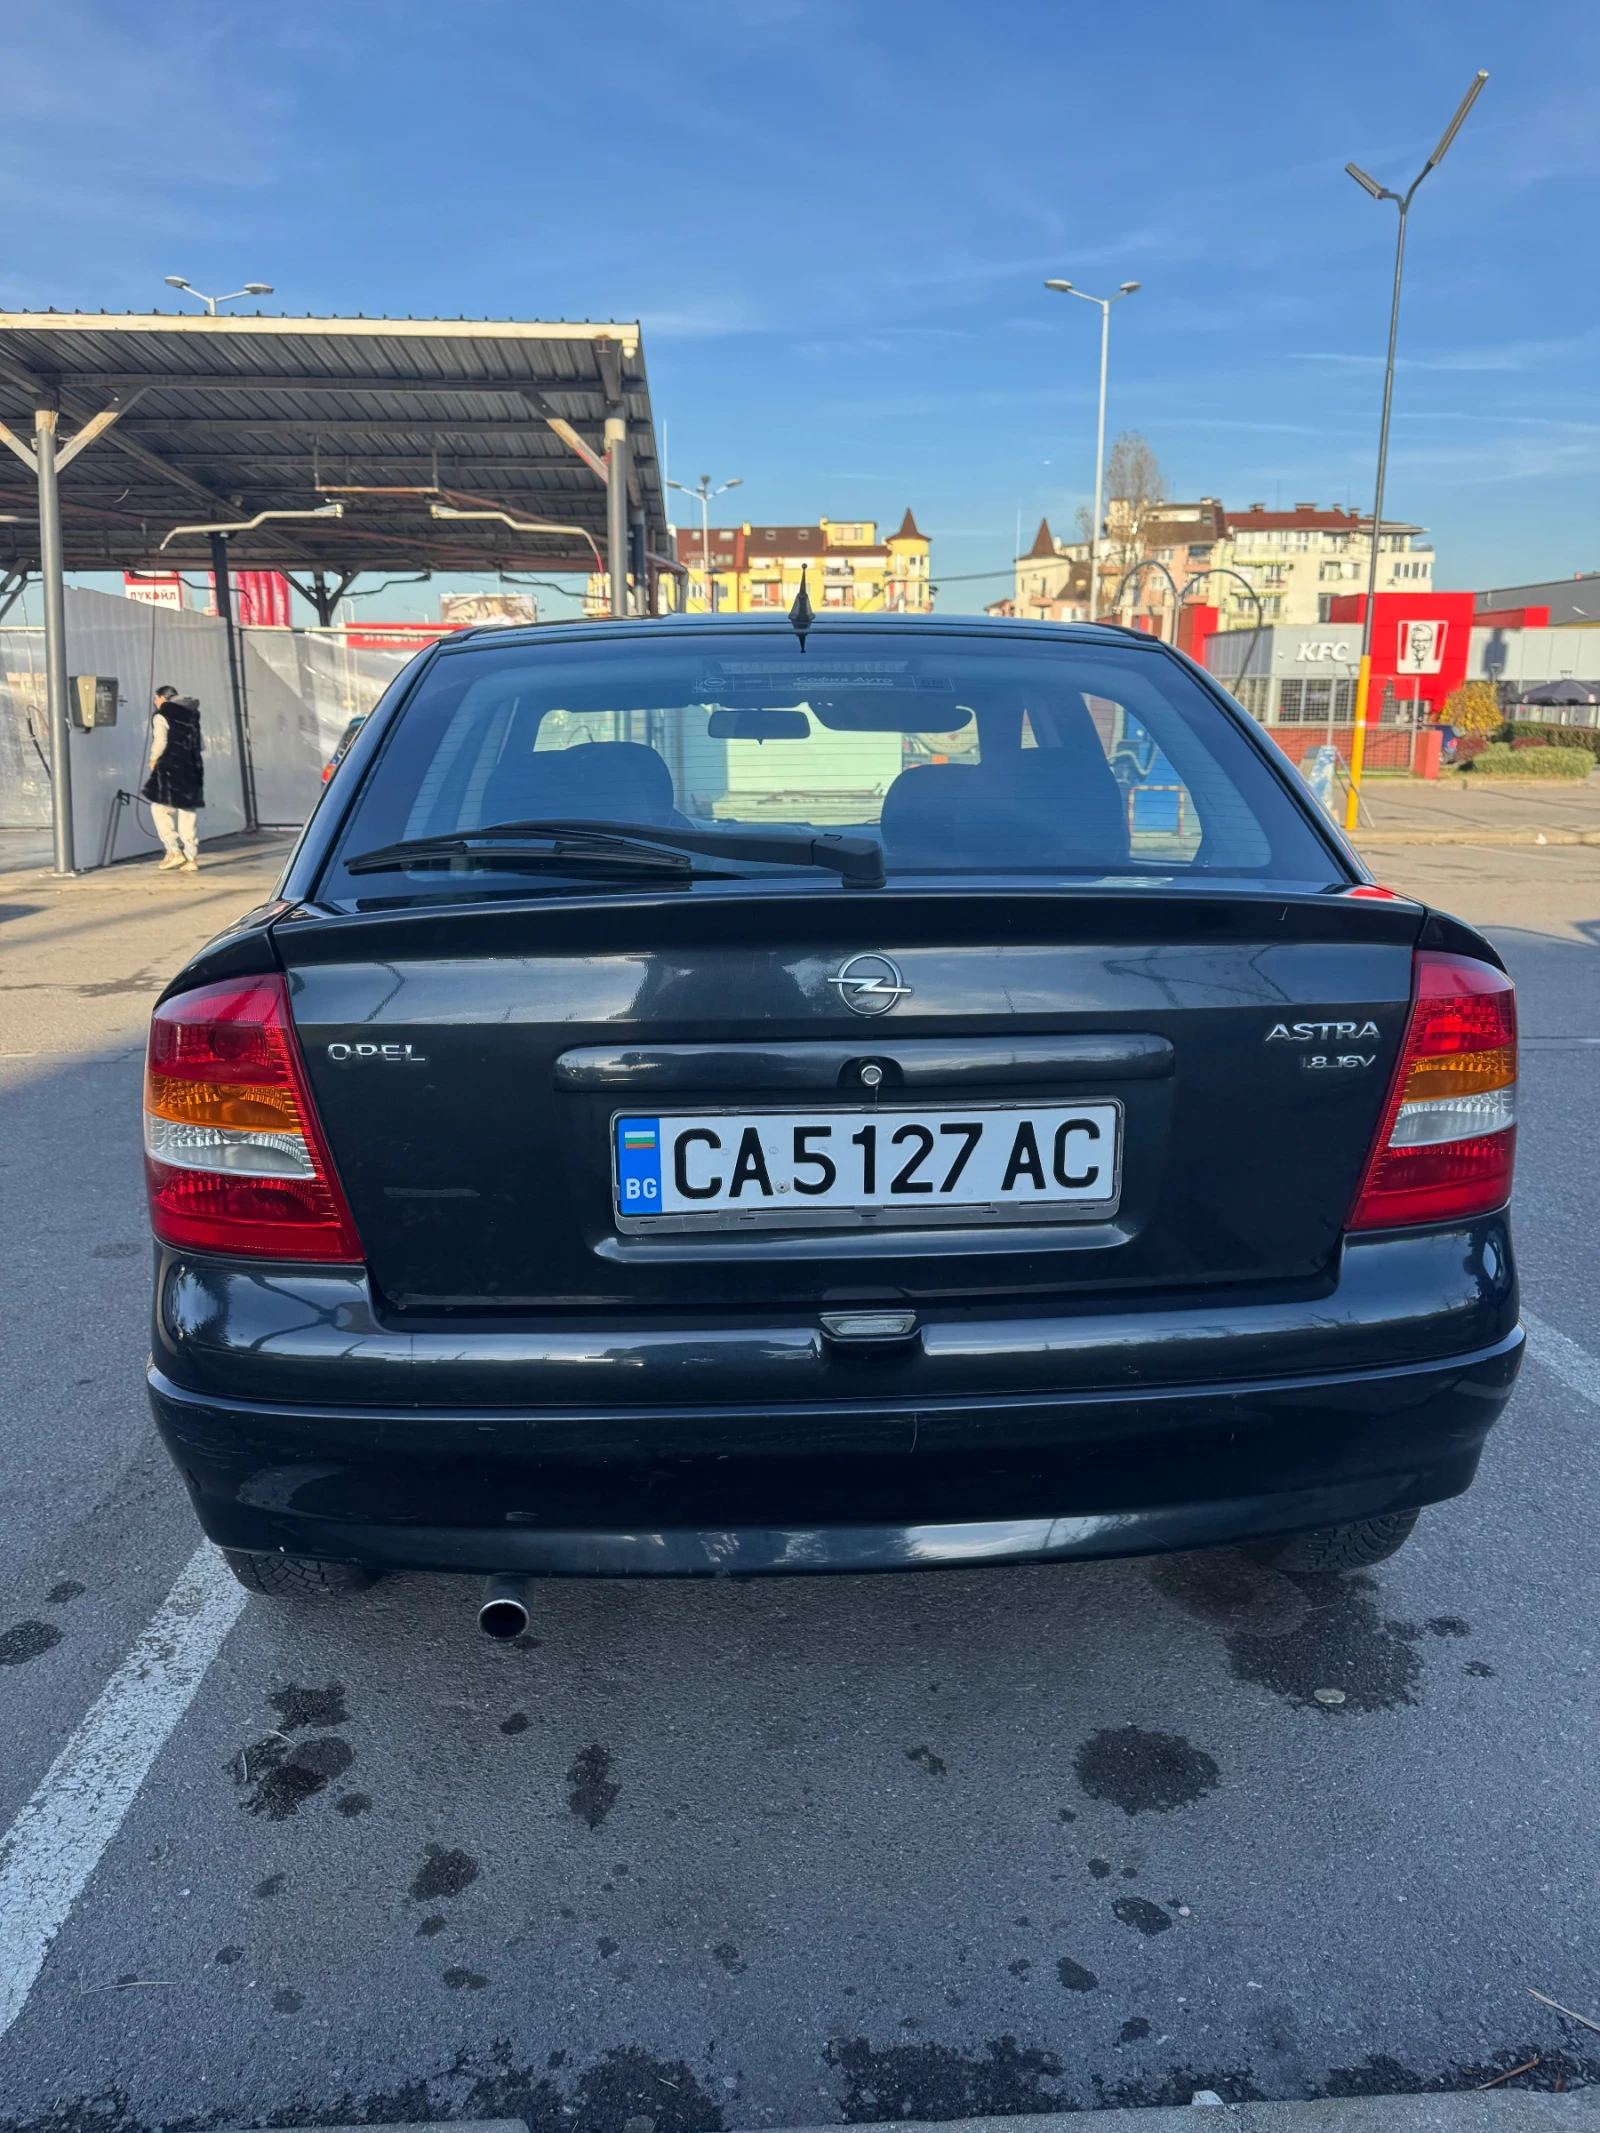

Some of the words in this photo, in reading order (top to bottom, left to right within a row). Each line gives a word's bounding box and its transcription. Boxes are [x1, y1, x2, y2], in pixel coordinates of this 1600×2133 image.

[1294, 642, 1350, 662] KFC
[796, 676, 848, 684] София
[853, 676, 893, 684] Ауто
[1265, 1021, 1380, 1041] ASTRA
[327, 1043, 426, 1061] OPEL
[673, 1127, 774, 1199] CA
[793, 1122, 984, 1196] 5127
[1001, 1118, 1101, 1191] AC
[626, 1177, 657, 1199] BG
